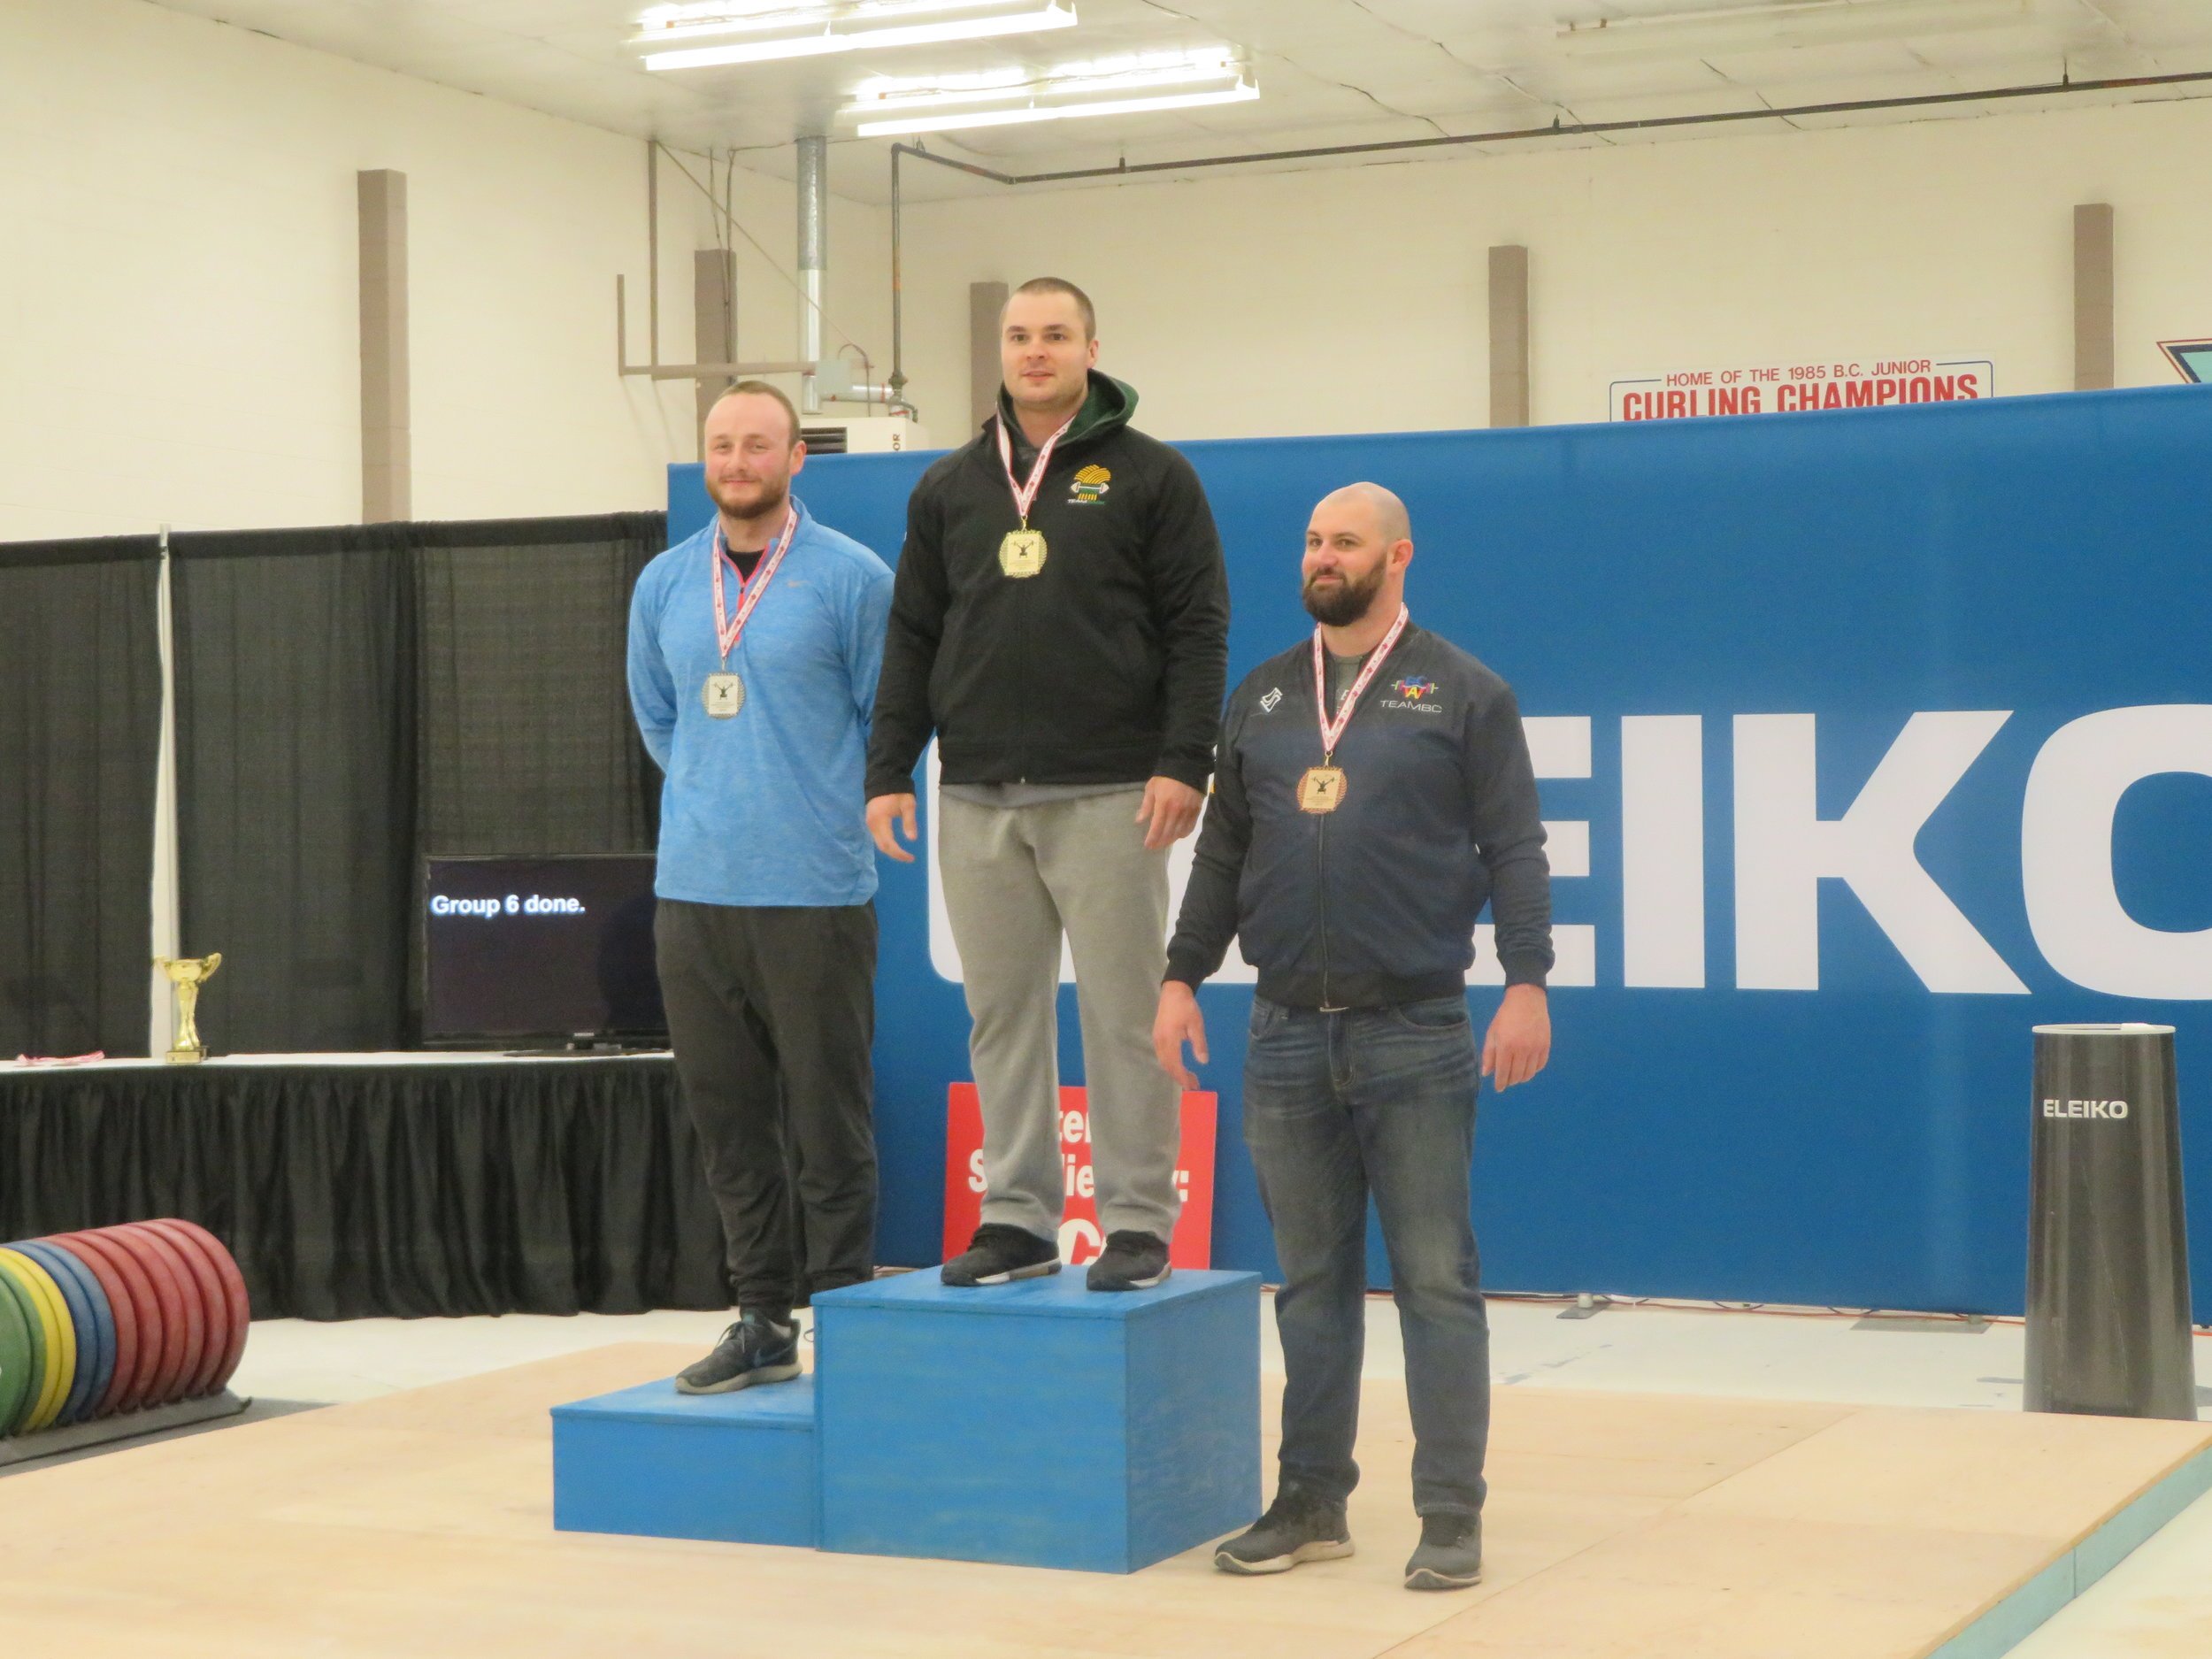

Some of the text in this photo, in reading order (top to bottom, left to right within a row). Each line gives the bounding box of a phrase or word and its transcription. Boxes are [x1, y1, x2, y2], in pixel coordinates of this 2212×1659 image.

[1666, 359, 1932, 387] HOME OF THE 1985 B.C. JUNIOR
[1623, 373, 1978, 422] CURLING CHAMPIONS
[1380, 700, 1443, 713] TEAMBC
[431, 894, 586, 919] Group 6 done.
[2043, 1099, 2129, 1119] ELEIKO
